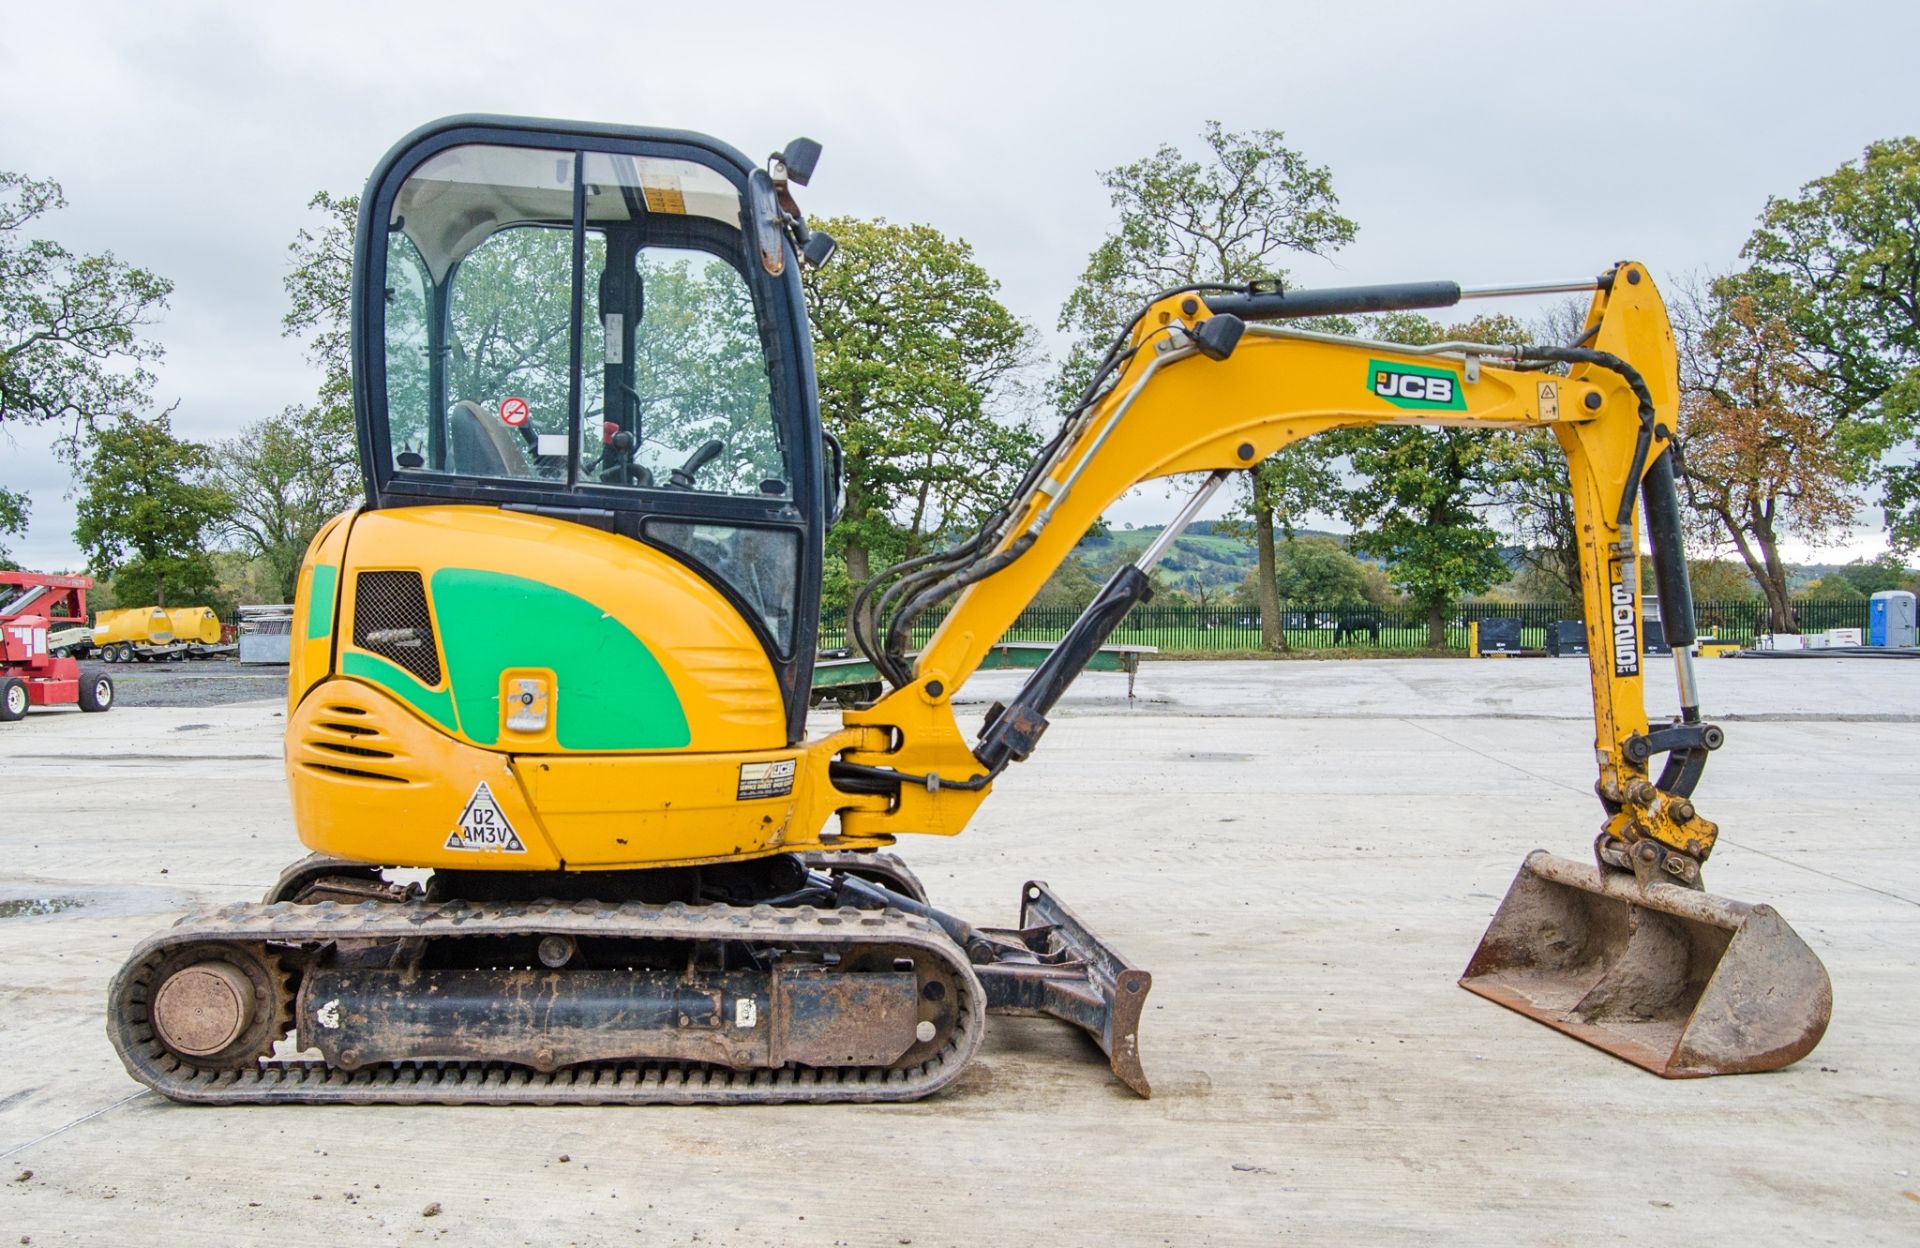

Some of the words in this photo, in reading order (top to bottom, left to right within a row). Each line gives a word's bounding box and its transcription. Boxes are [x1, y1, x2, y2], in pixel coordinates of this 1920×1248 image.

[1376, 373, 1452, 402] JCB
[1611, 584, 1637, 665] 8025
[463, 826, 507, 843] AM3V
